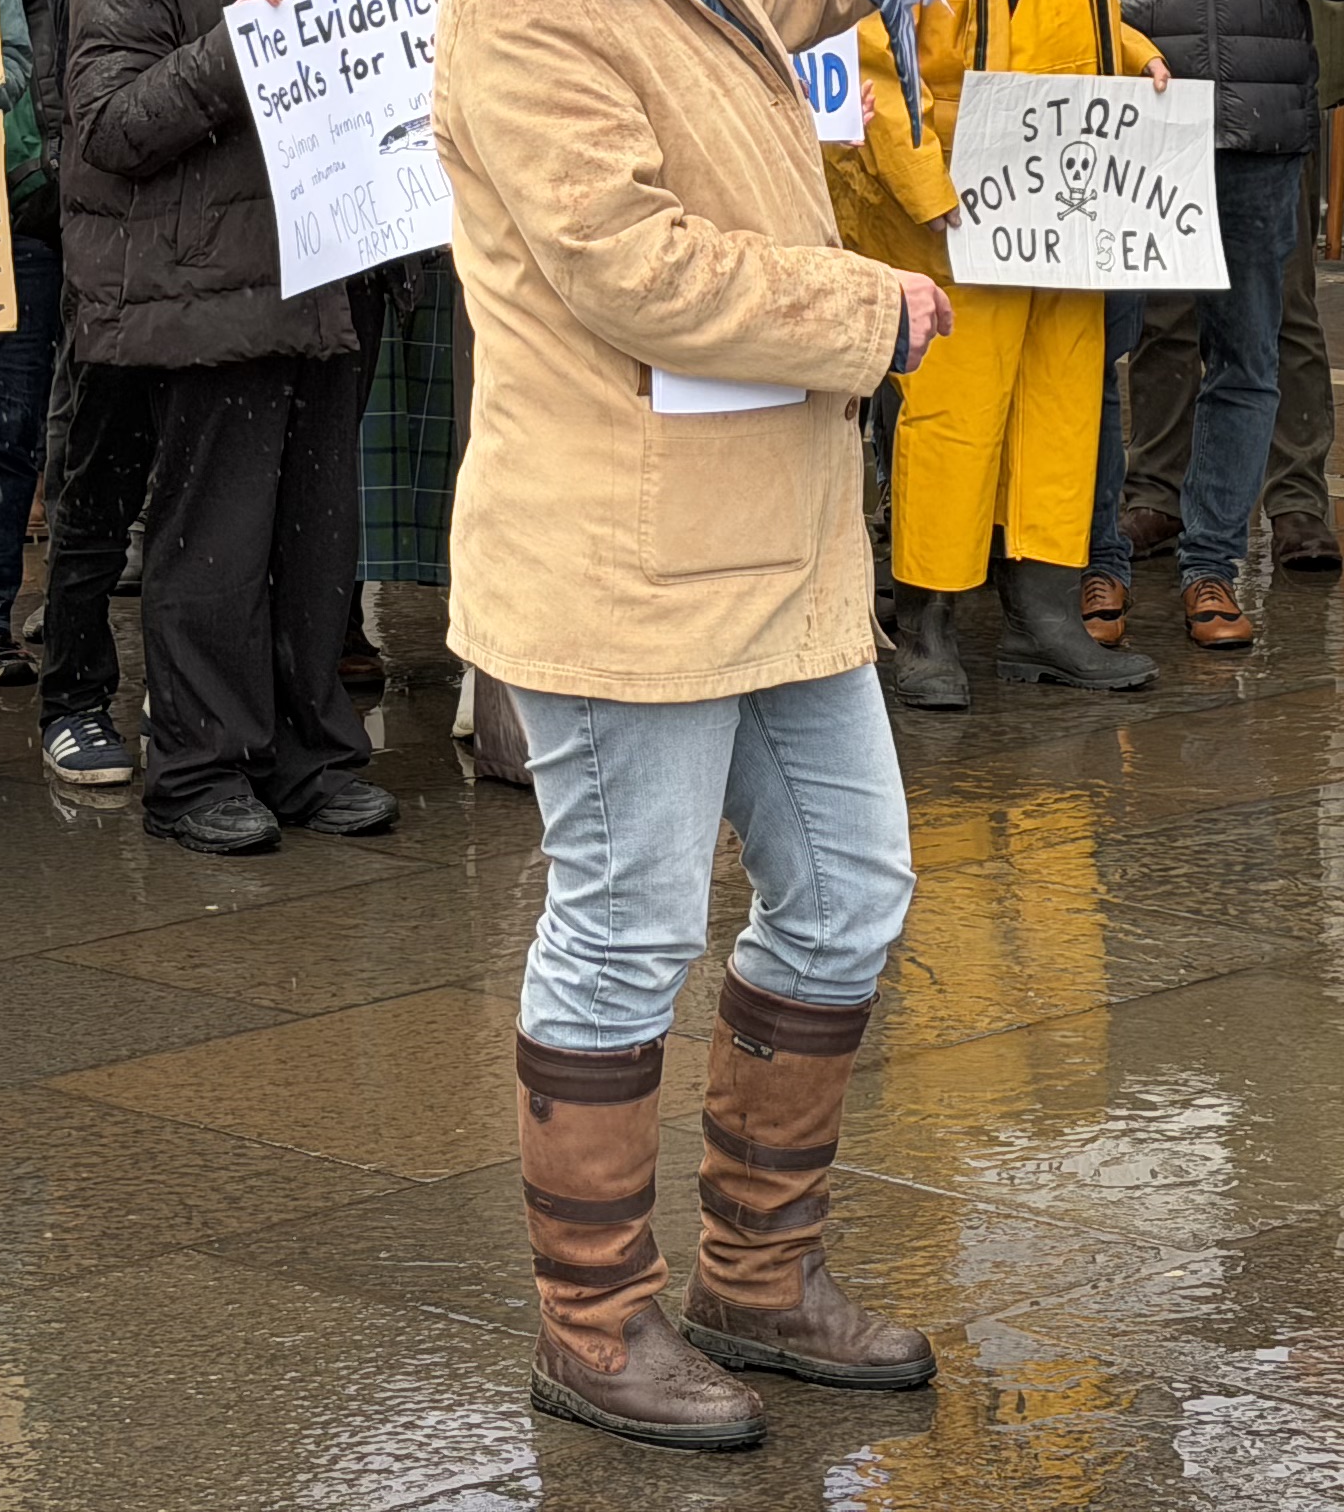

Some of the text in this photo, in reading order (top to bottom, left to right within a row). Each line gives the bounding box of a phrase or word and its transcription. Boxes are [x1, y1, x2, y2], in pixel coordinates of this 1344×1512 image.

[237, 17, 289, 68] The
[257, 48, 385, 123] Speaks for
[294, 180, 388, 261] NO MORE
[357, 216, 415, 267] FARMS!
[992, 226, 1167, 272] OUR SEA
